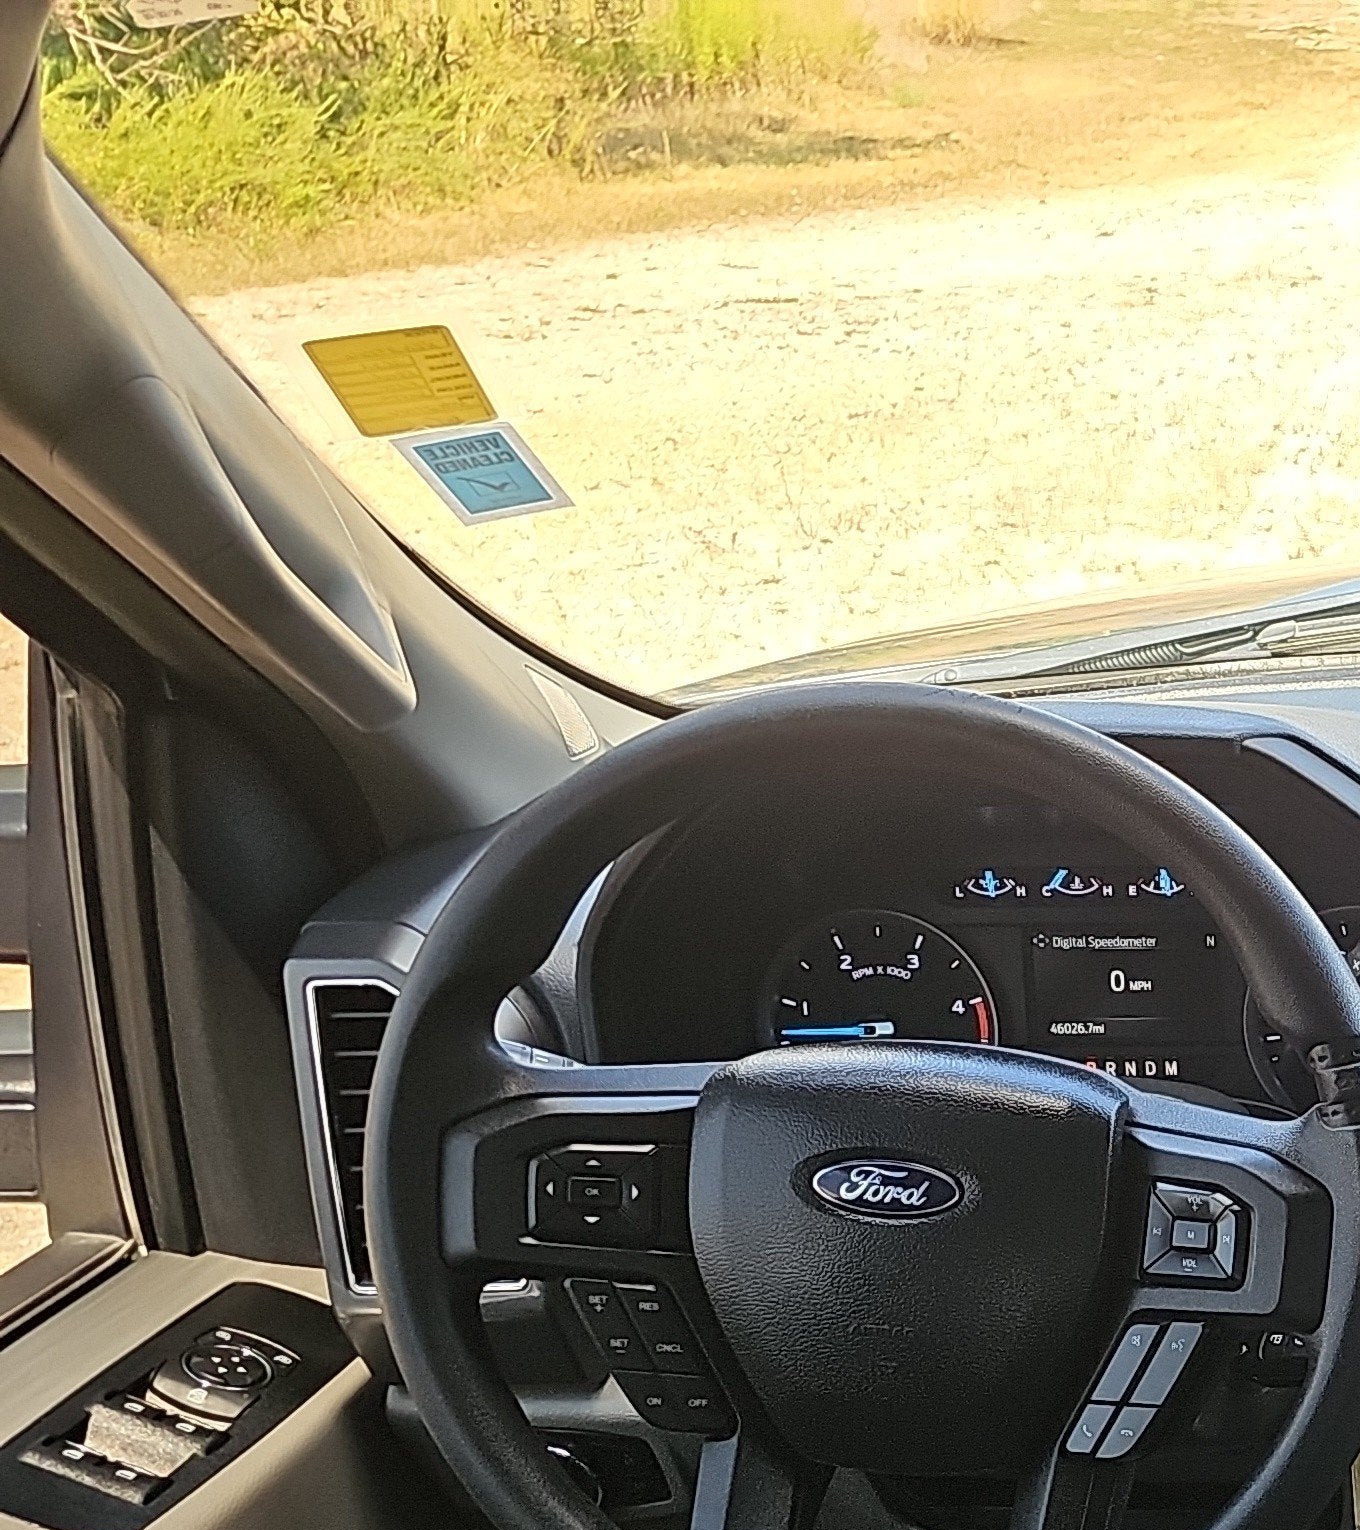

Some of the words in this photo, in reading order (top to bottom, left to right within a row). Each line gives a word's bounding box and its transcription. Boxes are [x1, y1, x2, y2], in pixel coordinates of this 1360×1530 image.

[955, 886, 964, 897] L
[1017, 886, 1026, 896] H
[1042, 886, 1051, 897] C
[1103, 886, 1113, 896] H
[1128, 885, 1137, 896] E
[1052, 935, 1086, 949] Digital
[1088, 936, 1157, 949] Speedometer
[1206, 936, 1215, 947] N
[839, 954, 853, 970] 2
[906, 954, 920, 969] 3
[851, 966, 874, 980] RPM
[886, 966, 912, 980] 1000
[1110, 970, 1125, 992] 0
[1129, 980, 1152, 991] MPH
[951, 999, 966, 1015] 4
[1105, 1061, 1117, 1076] R
[1125, 1061, 1137, 1076] N
[1145, 1061, 1157, 1076] D
[1165, 1060, 1178, 1076] M
[838, 1166, 930, 1207] Ford
